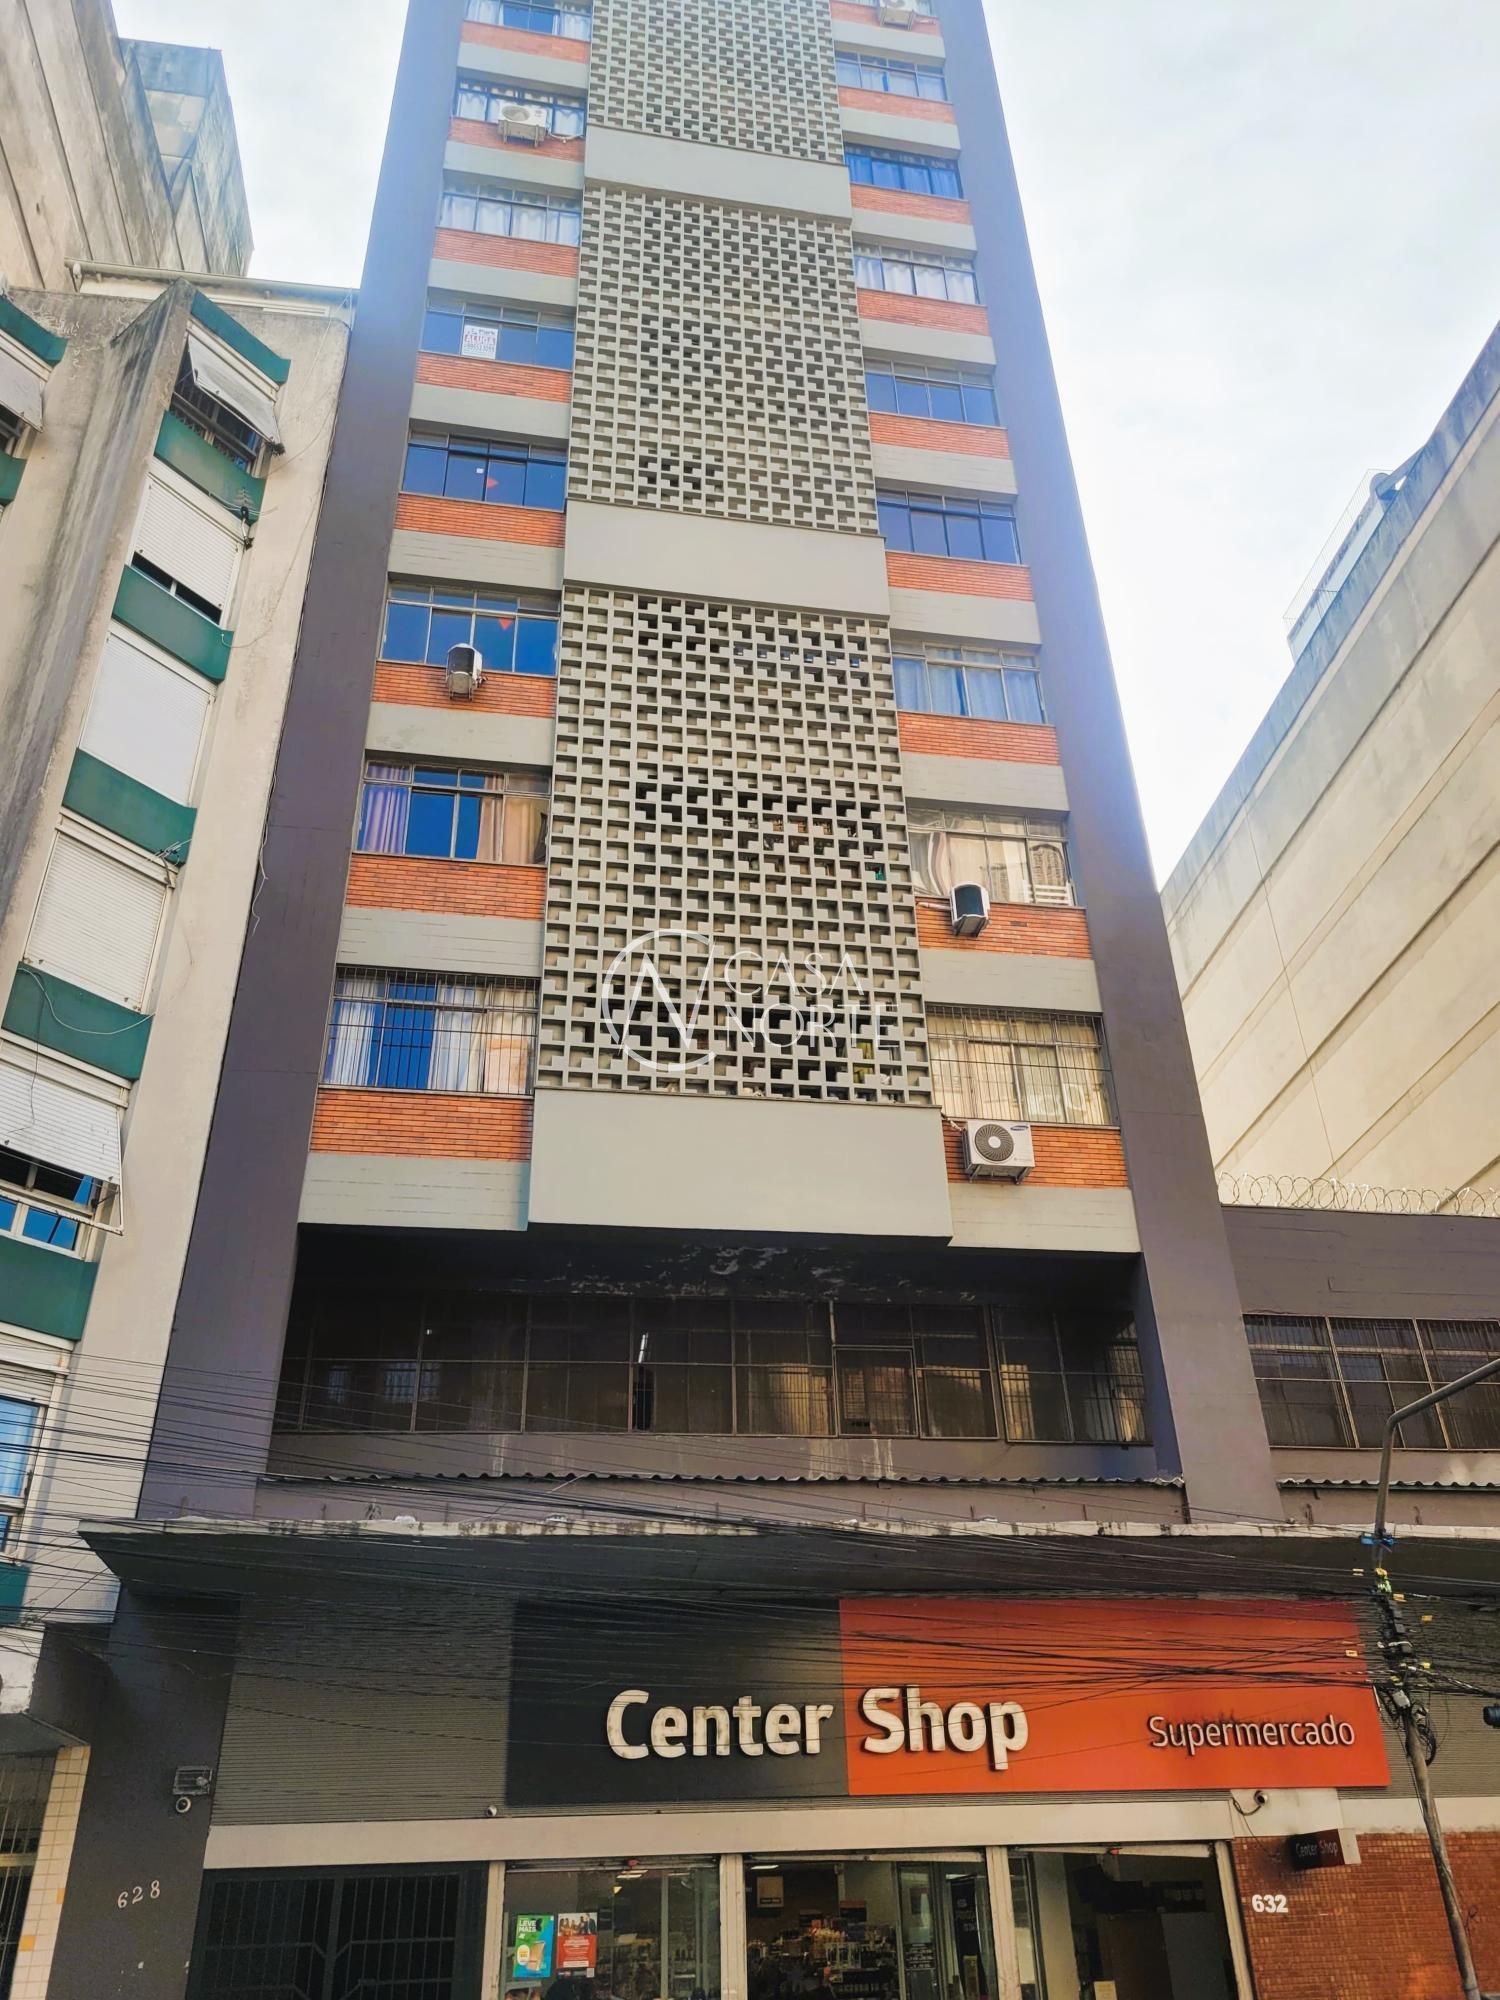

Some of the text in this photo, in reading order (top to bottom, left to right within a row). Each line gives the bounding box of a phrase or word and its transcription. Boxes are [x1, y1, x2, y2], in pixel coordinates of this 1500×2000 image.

[606, 1684, 1029, 1771] Center Shop
[1148, 1714, 1356, 1756] Supermercado
[1295, 1840, 1339, 1857] Center Shop
[117, 1879, 161, 1909] 628
[1251, 1894, 1289, 1913] 632
[519, 1919, 537, 1927] LEVE
